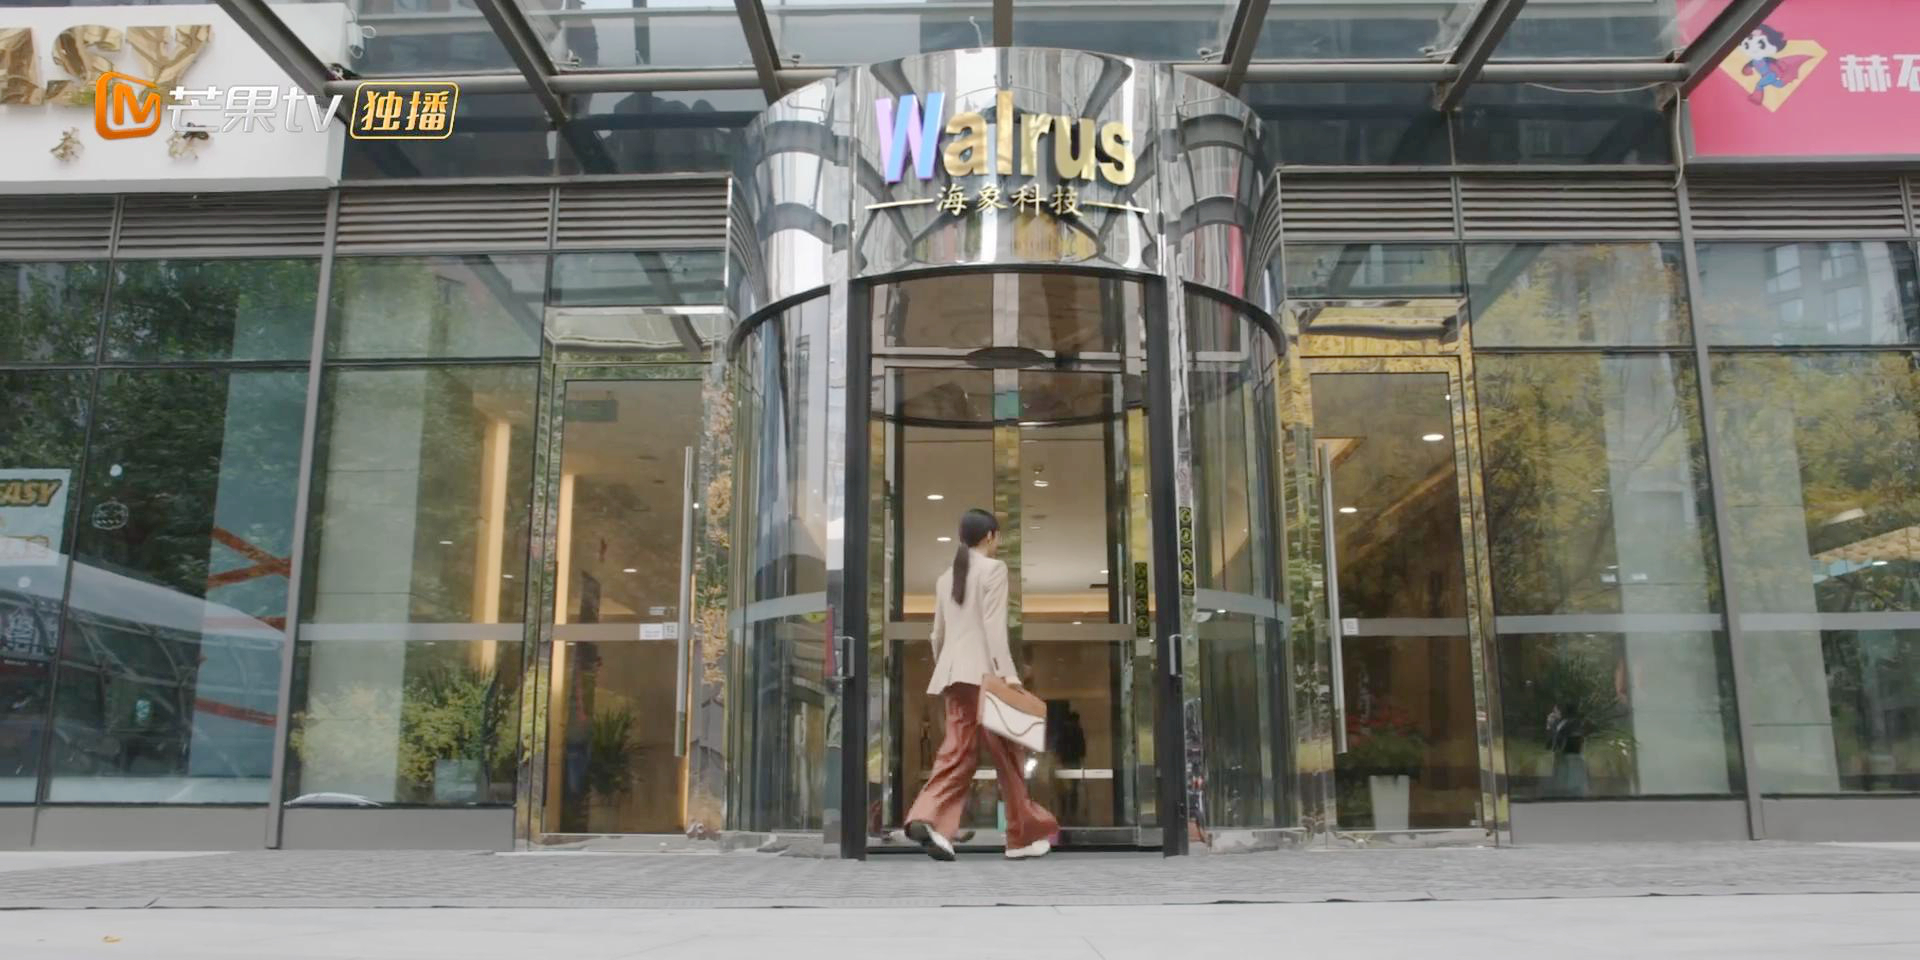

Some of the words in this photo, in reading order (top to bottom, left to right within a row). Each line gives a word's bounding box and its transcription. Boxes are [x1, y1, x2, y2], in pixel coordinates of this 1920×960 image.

[875, 90, 1136, 186] Walrus
[936, 182, 1084, 218] 海象科技
[0, 479, 63, 507] ASY
